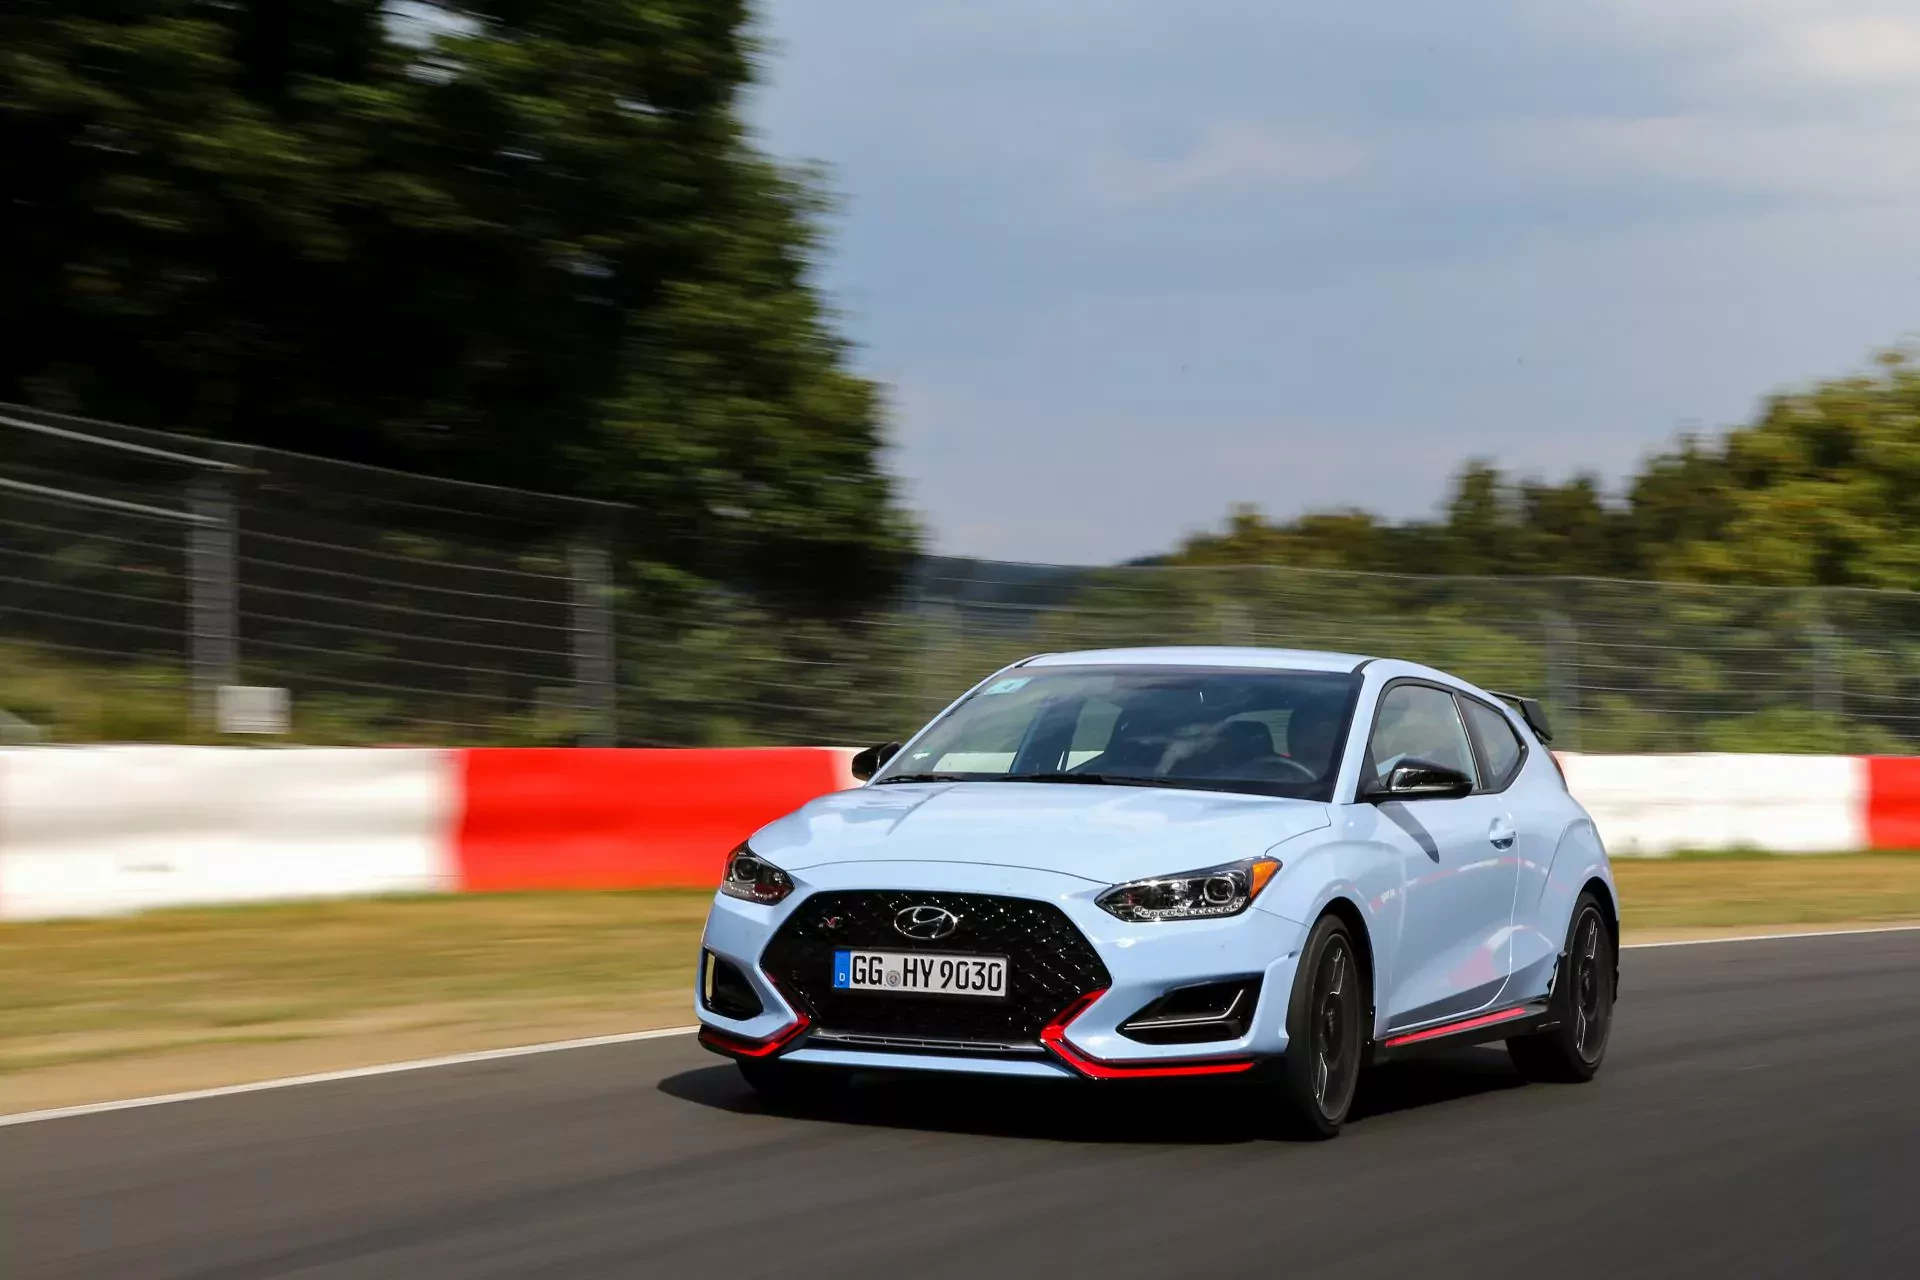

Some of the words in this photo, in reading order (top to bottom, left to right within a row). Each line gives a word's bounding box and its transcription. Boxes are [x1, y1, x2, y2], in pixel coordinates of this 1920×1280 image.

[839, 972, 846, 982] D
[852, 955, 883, 985] GG
[903, 957, 935, 988] HY
[940, 960, 1002, 992] 9030
